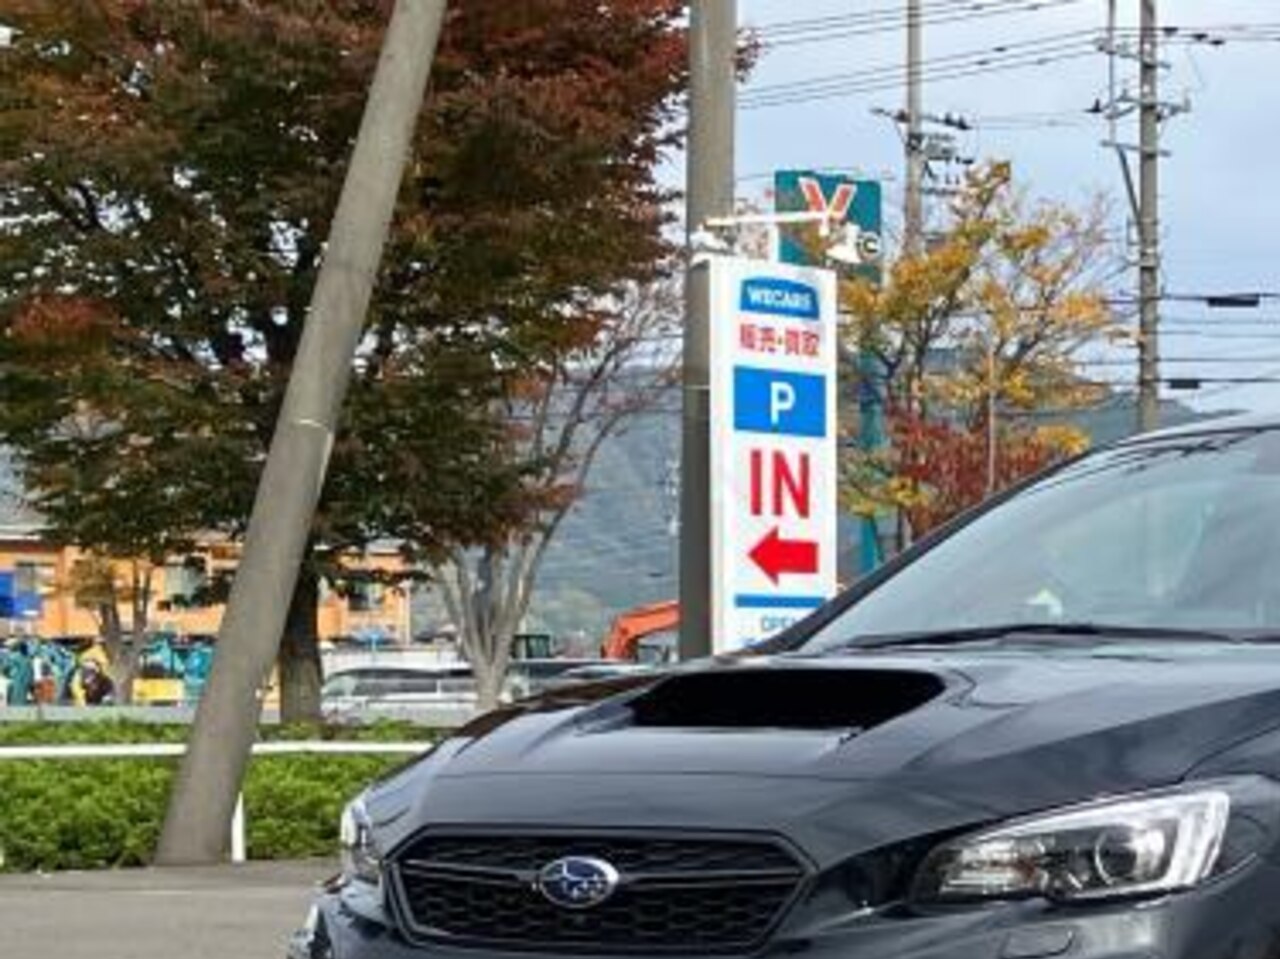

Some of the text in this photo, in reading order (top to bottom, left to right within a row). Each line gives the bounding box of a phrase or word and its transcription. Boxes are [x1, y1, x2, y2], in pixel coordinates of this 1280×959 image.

[745, 284, 814, 311] WECARS
[769, 382, 796, 424] P
[750, 450, 810, 519] IN
